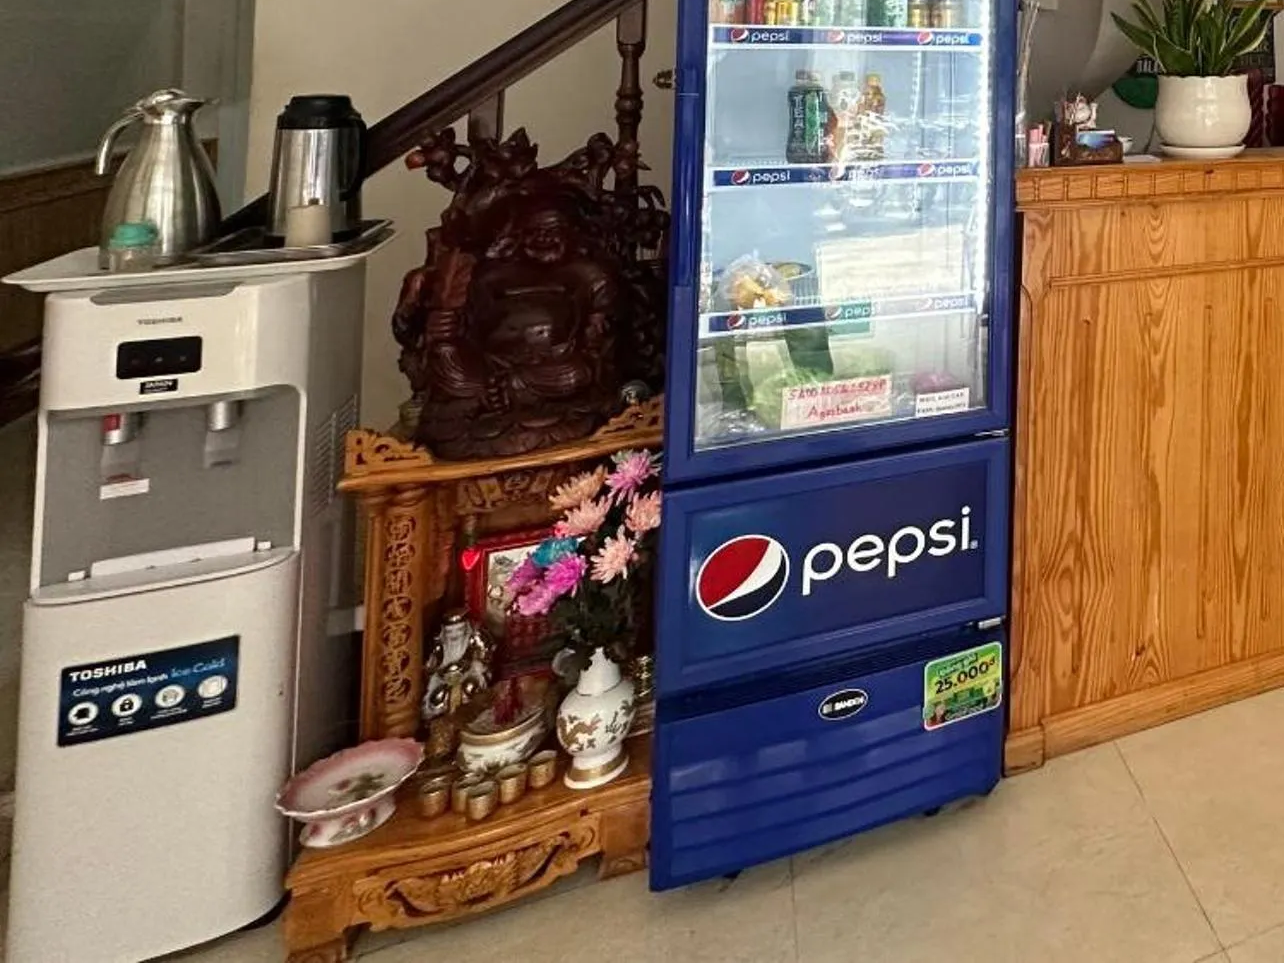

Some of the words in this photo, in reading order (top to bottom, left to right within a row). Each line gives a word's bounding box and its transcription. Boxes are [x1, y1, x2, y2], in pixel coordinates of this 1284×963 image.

[751, 30, 789, 43] pepsi
[934, 33, 969, 45] pepsi
[752, 170, 790, 183] pepsi
[748, 313, 787, 328] pepsi
[802, 505, 971, 596] pepsi
[69, 660, 147, 682] TOSHIBA
